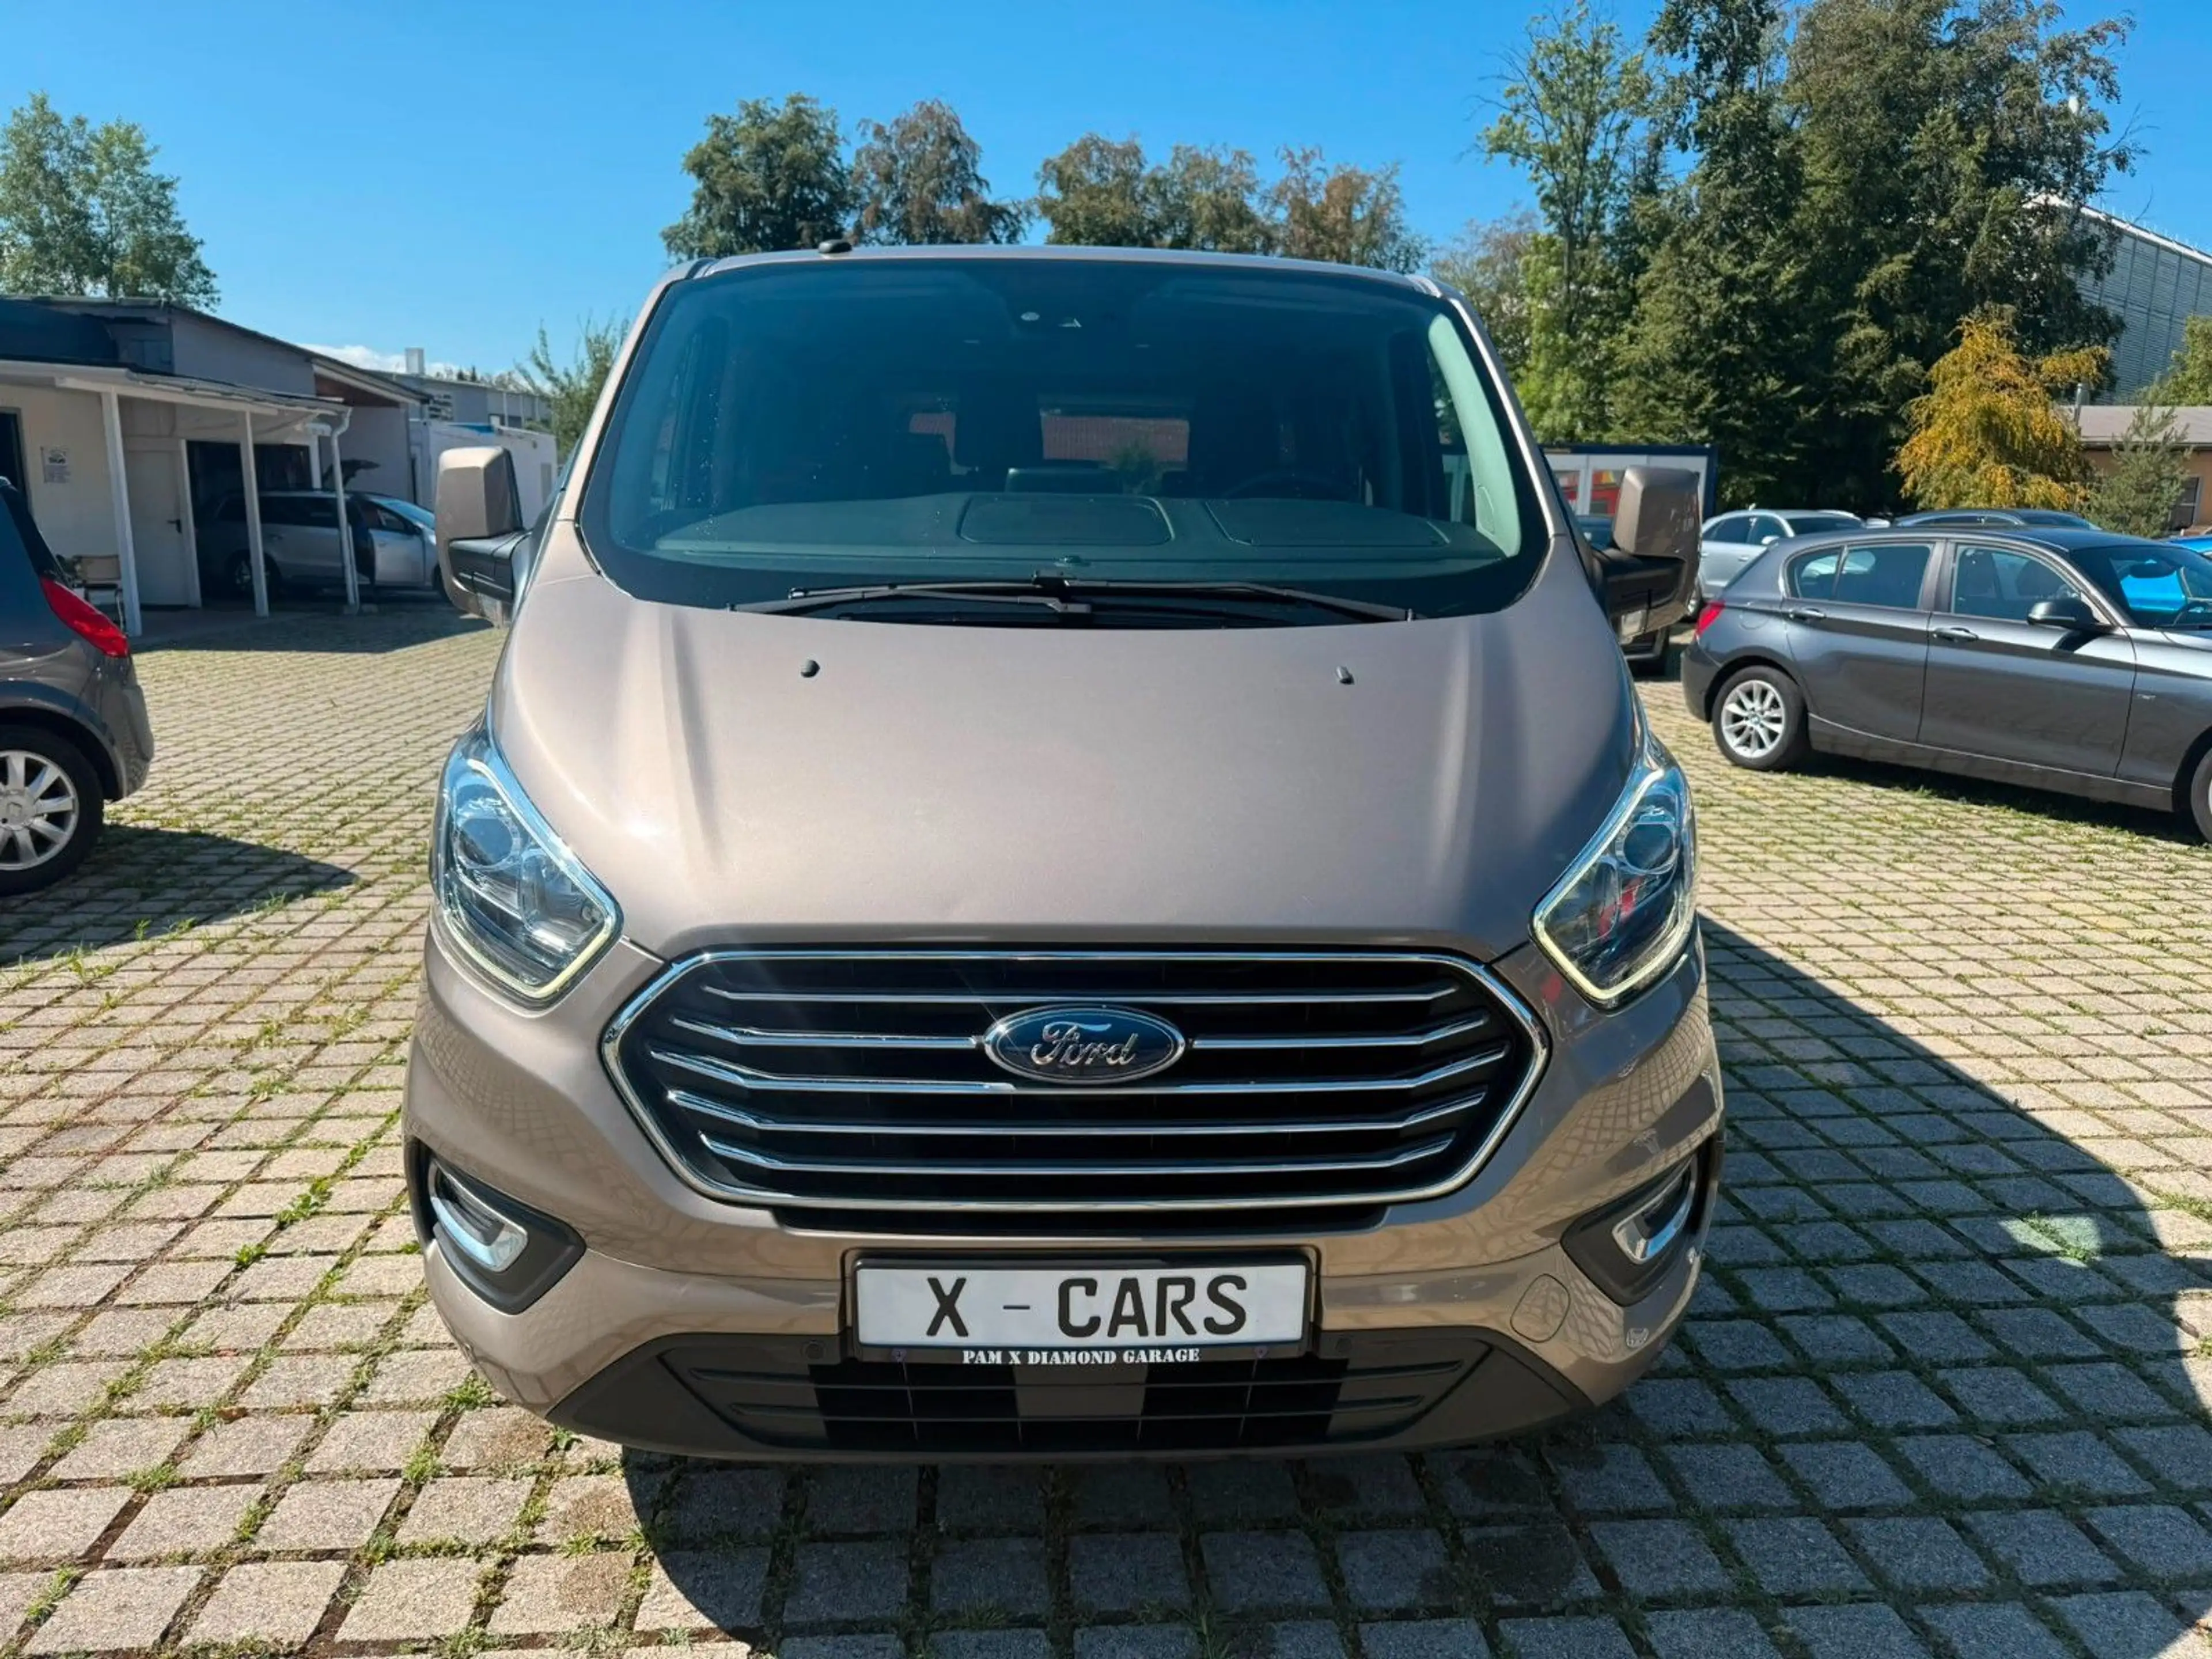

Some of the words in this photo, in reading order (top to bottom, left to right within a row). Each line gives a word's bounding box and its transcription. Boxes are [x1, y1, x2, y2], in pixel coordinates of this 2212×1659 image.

[1030, 1021, 1139, 1066] Ford
[925, 1277, 969, 1337] X
[1058, 1274, 1247, 1338] CARS
[962, 1350, 1002, 1364] PAM
[1008, 1350, 1021, 1364] X
[1027, 1350, 1116, 1365] DIAMOND
[1122, 1349, 1200, 1363] GARAGE
